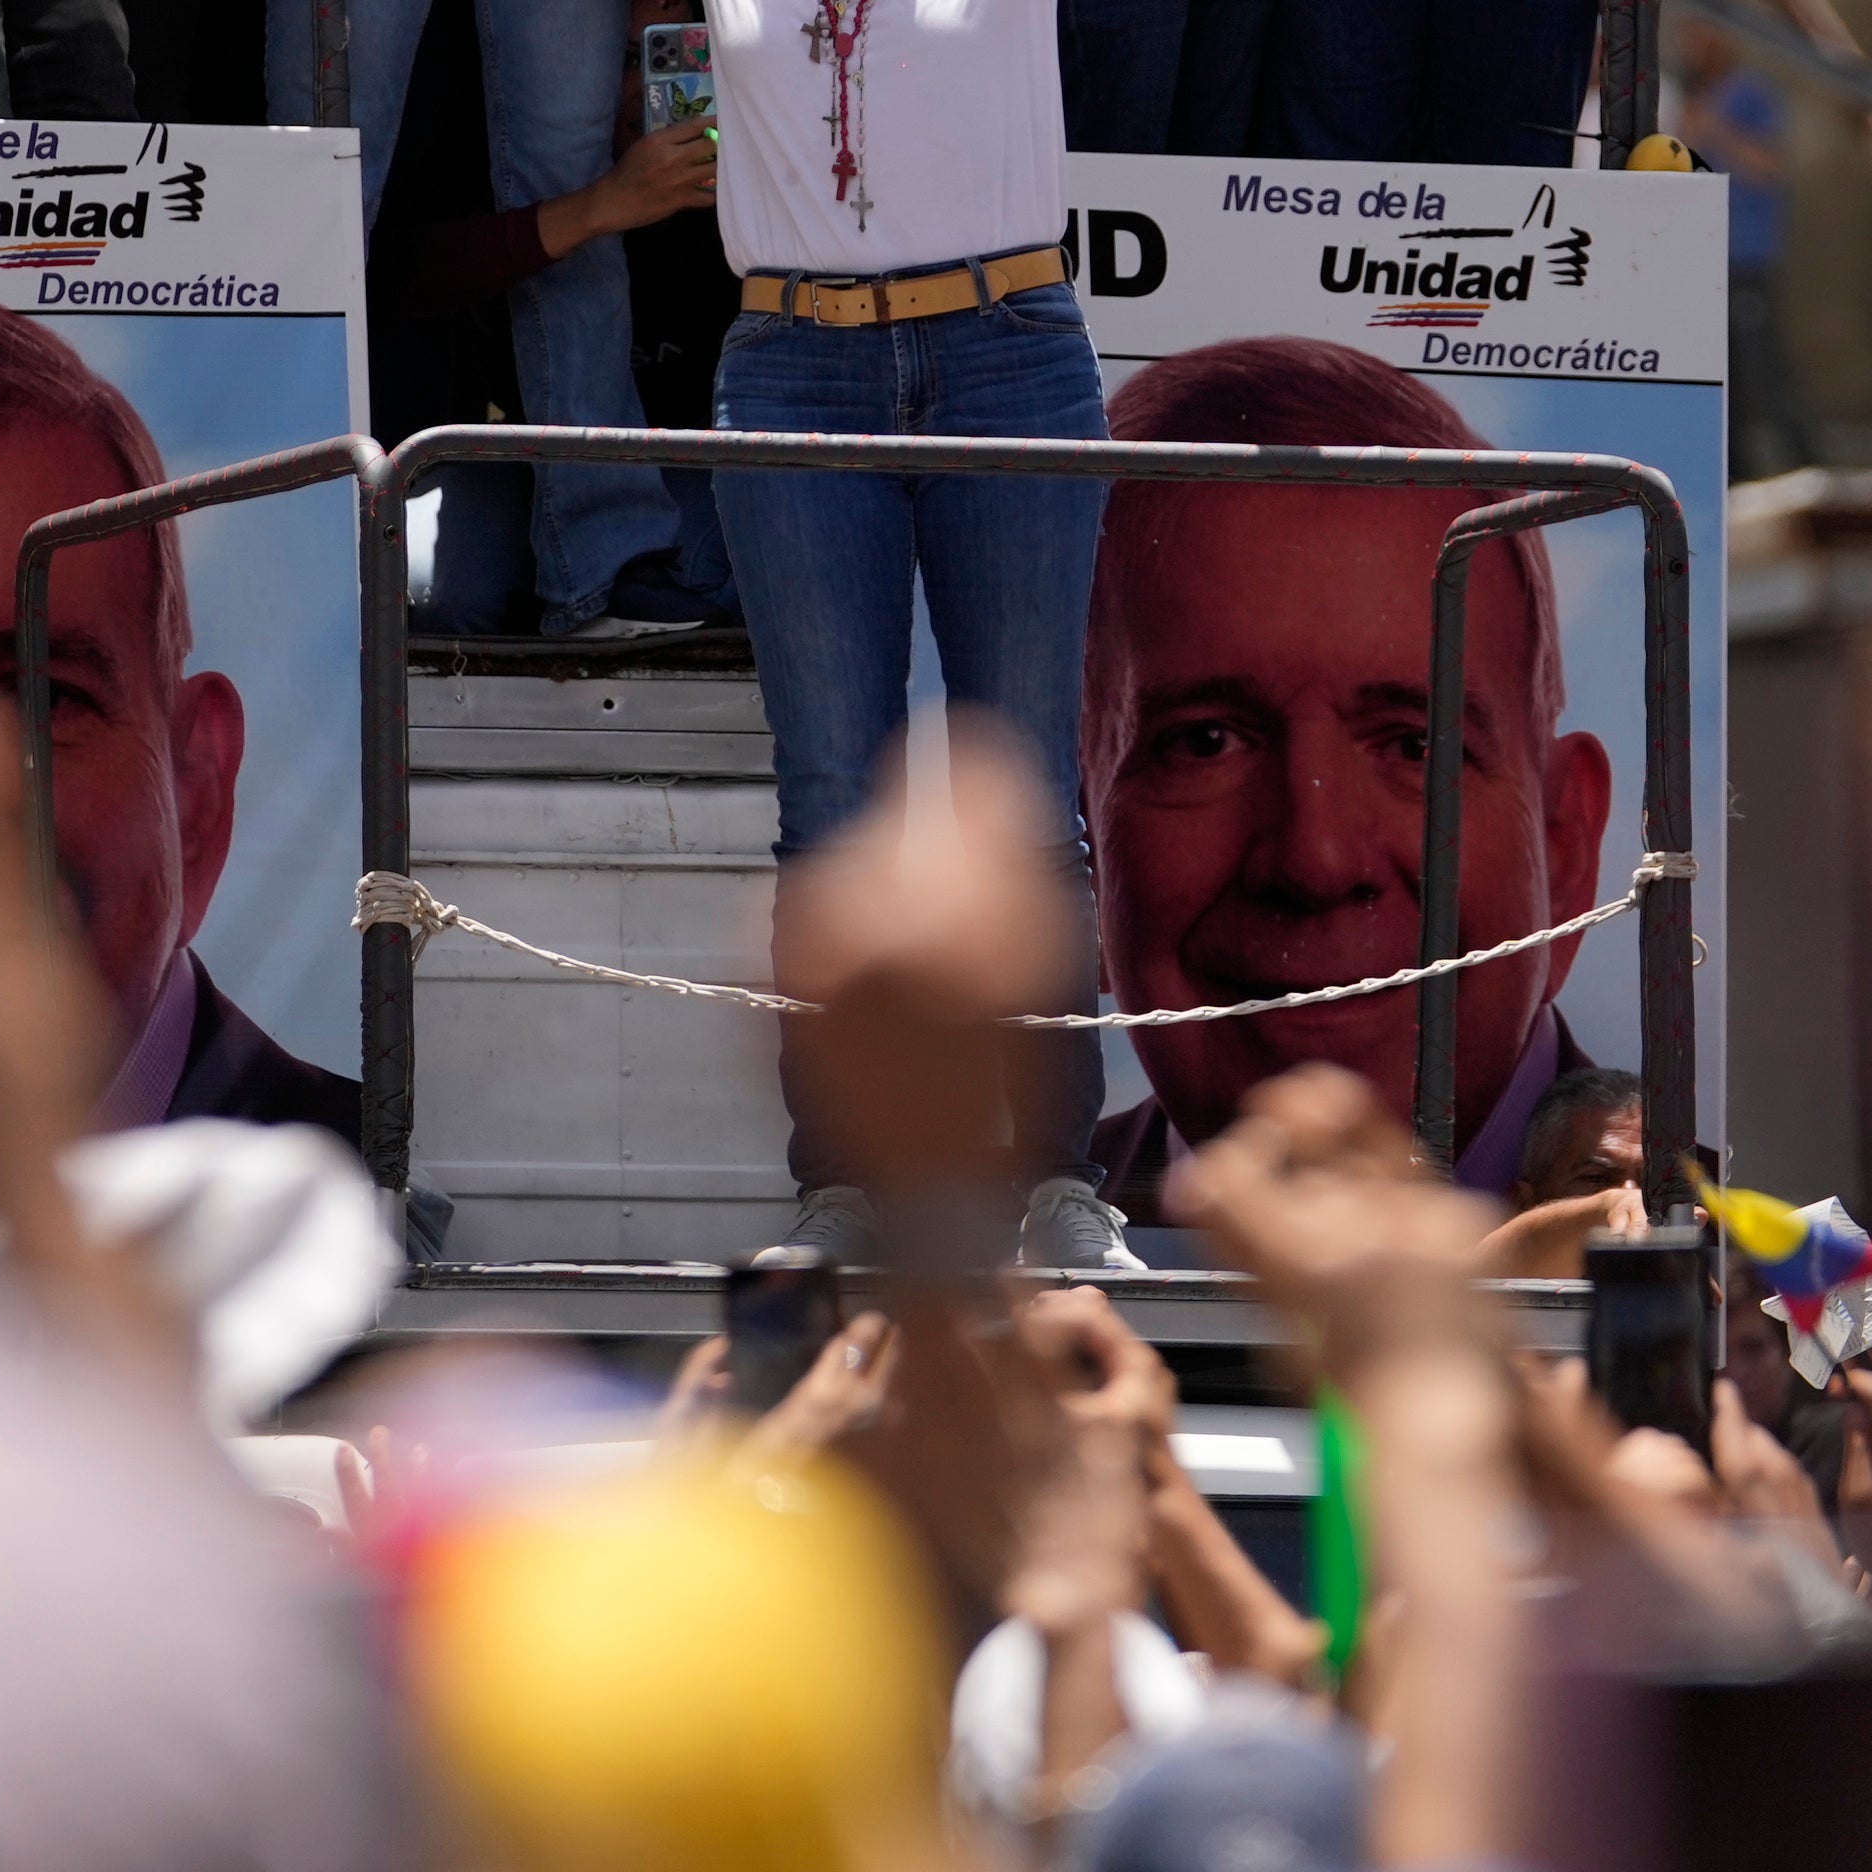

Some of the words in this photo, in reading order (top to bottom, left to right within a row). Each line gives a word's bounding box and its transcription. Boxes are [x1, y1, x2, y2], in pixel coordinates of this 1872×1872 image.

[25, 122, 59, 160] la
[1222, 174, 1341, 216] Mesa
[1357, 181, 1408, 220] de
[1412, 183, 1446, 221] la
[37, 272, 280, 307] Democrática
[1319, 245, 1535, 302] Unidad
[1422, 332, 1660, 373] Democrática
